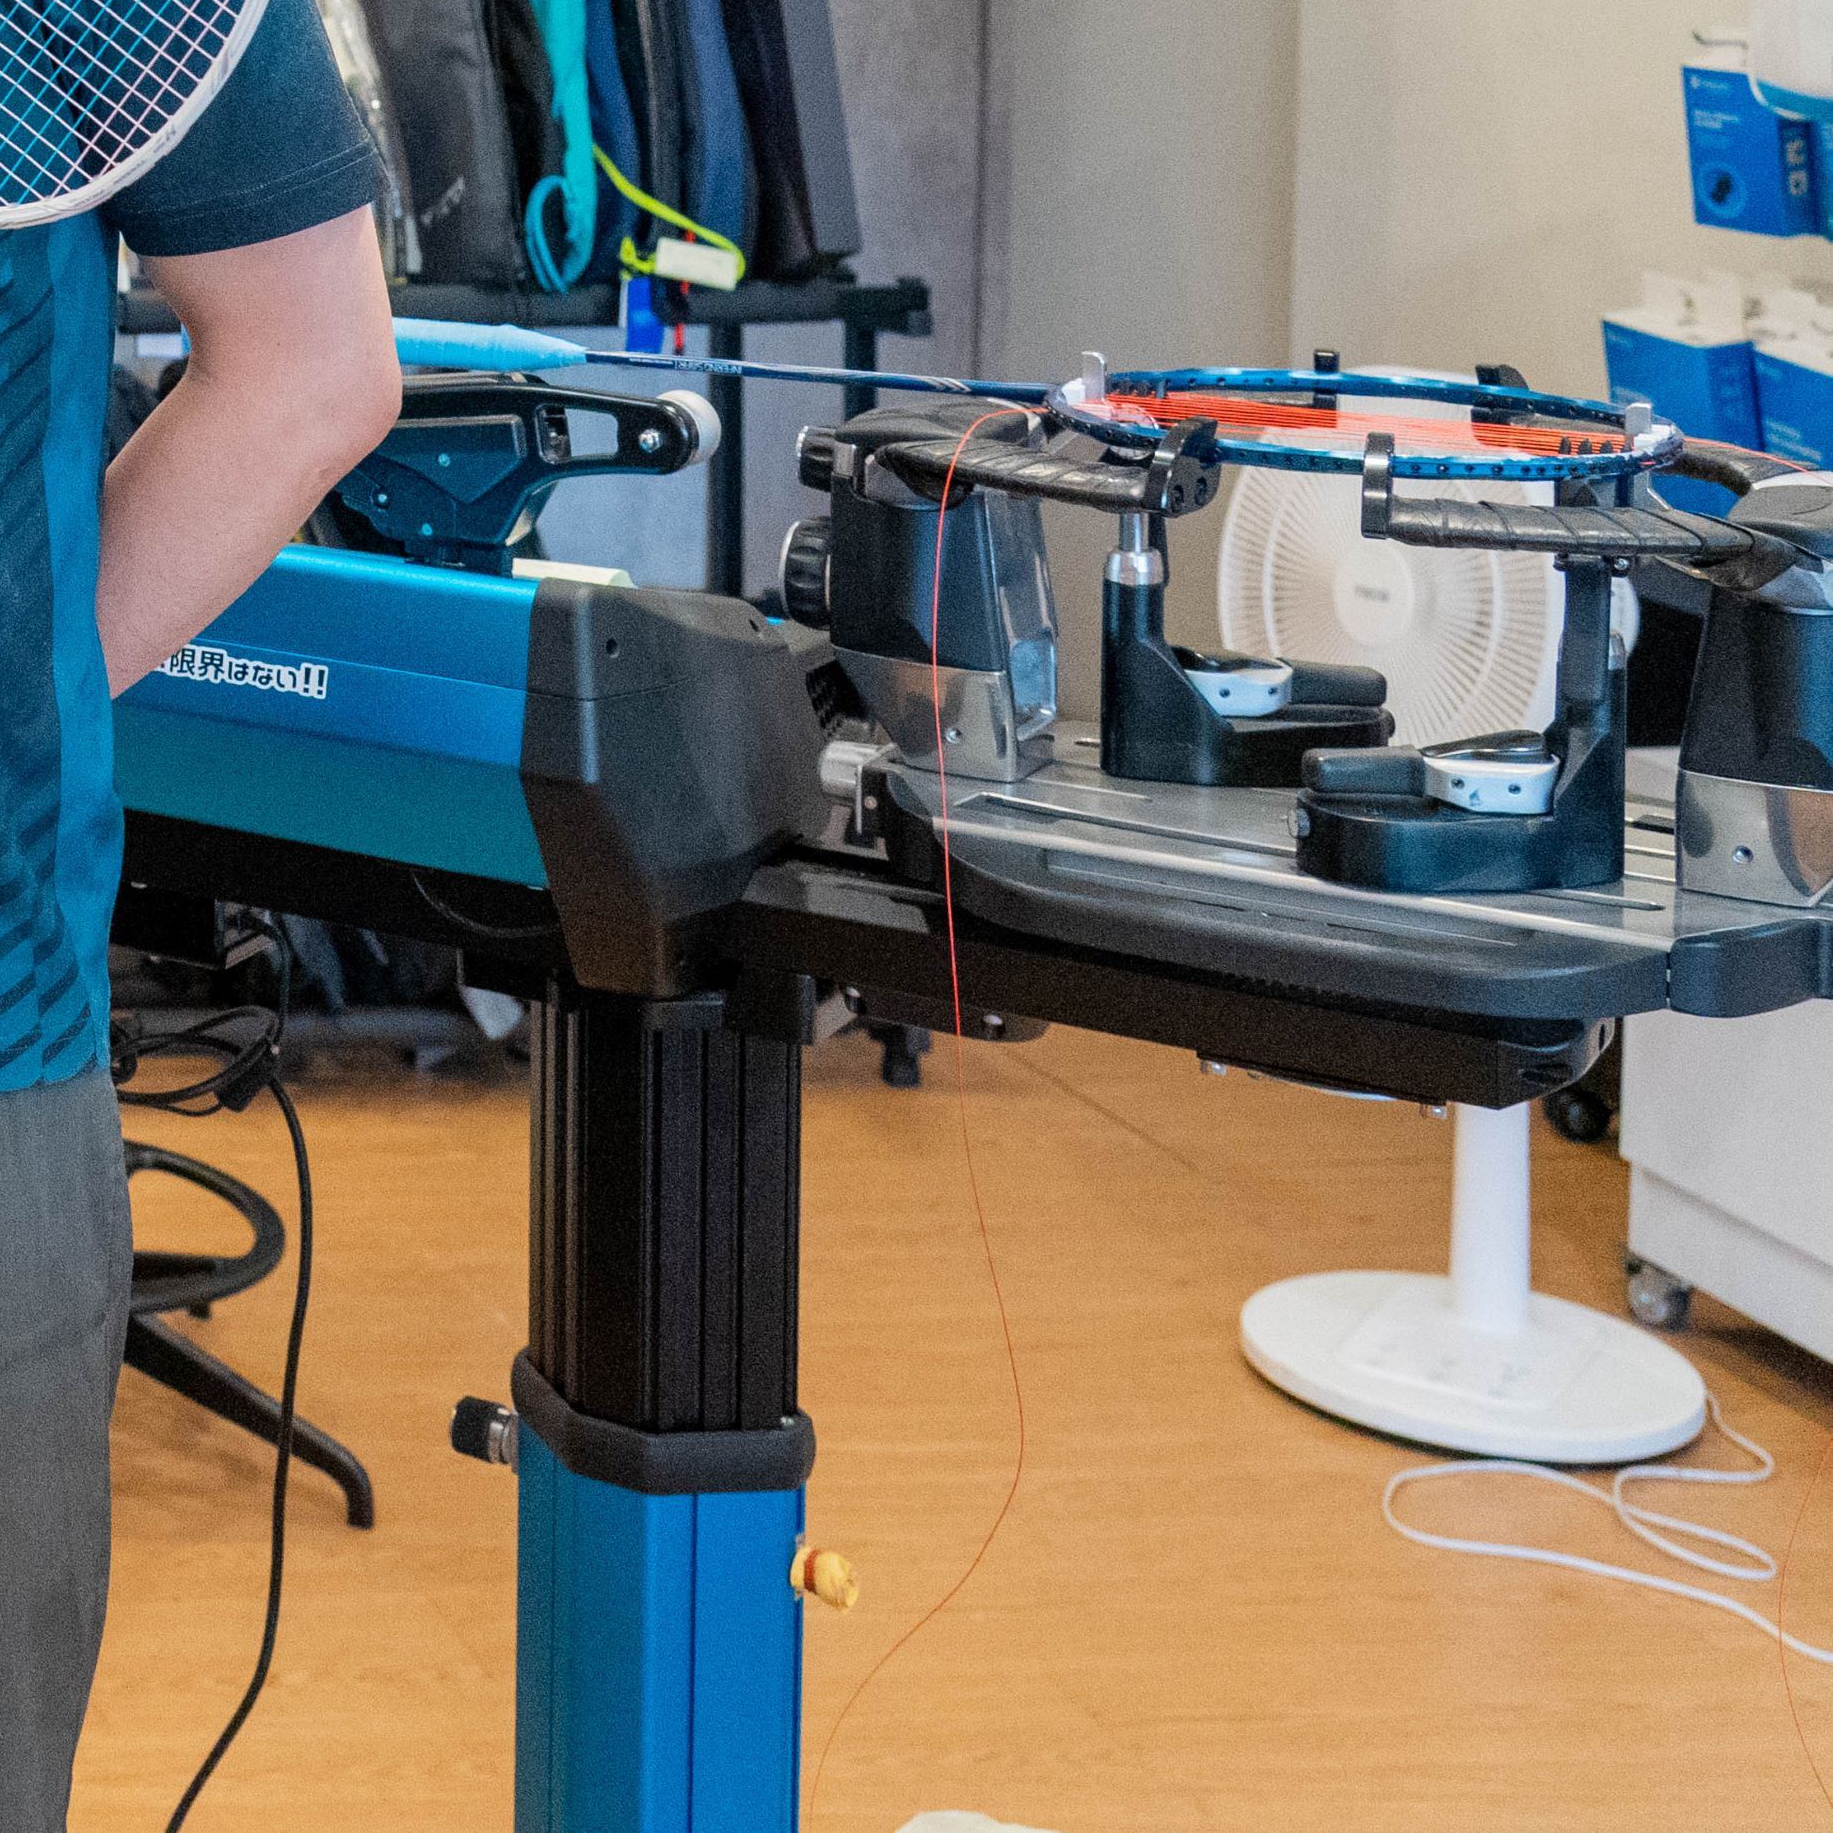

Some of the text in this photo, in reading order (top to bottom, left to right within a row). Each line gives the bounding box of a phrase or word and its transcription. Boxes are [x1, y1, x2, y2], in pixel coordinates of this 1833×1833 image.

[159, 648, 327, 697] 限界はない!!
